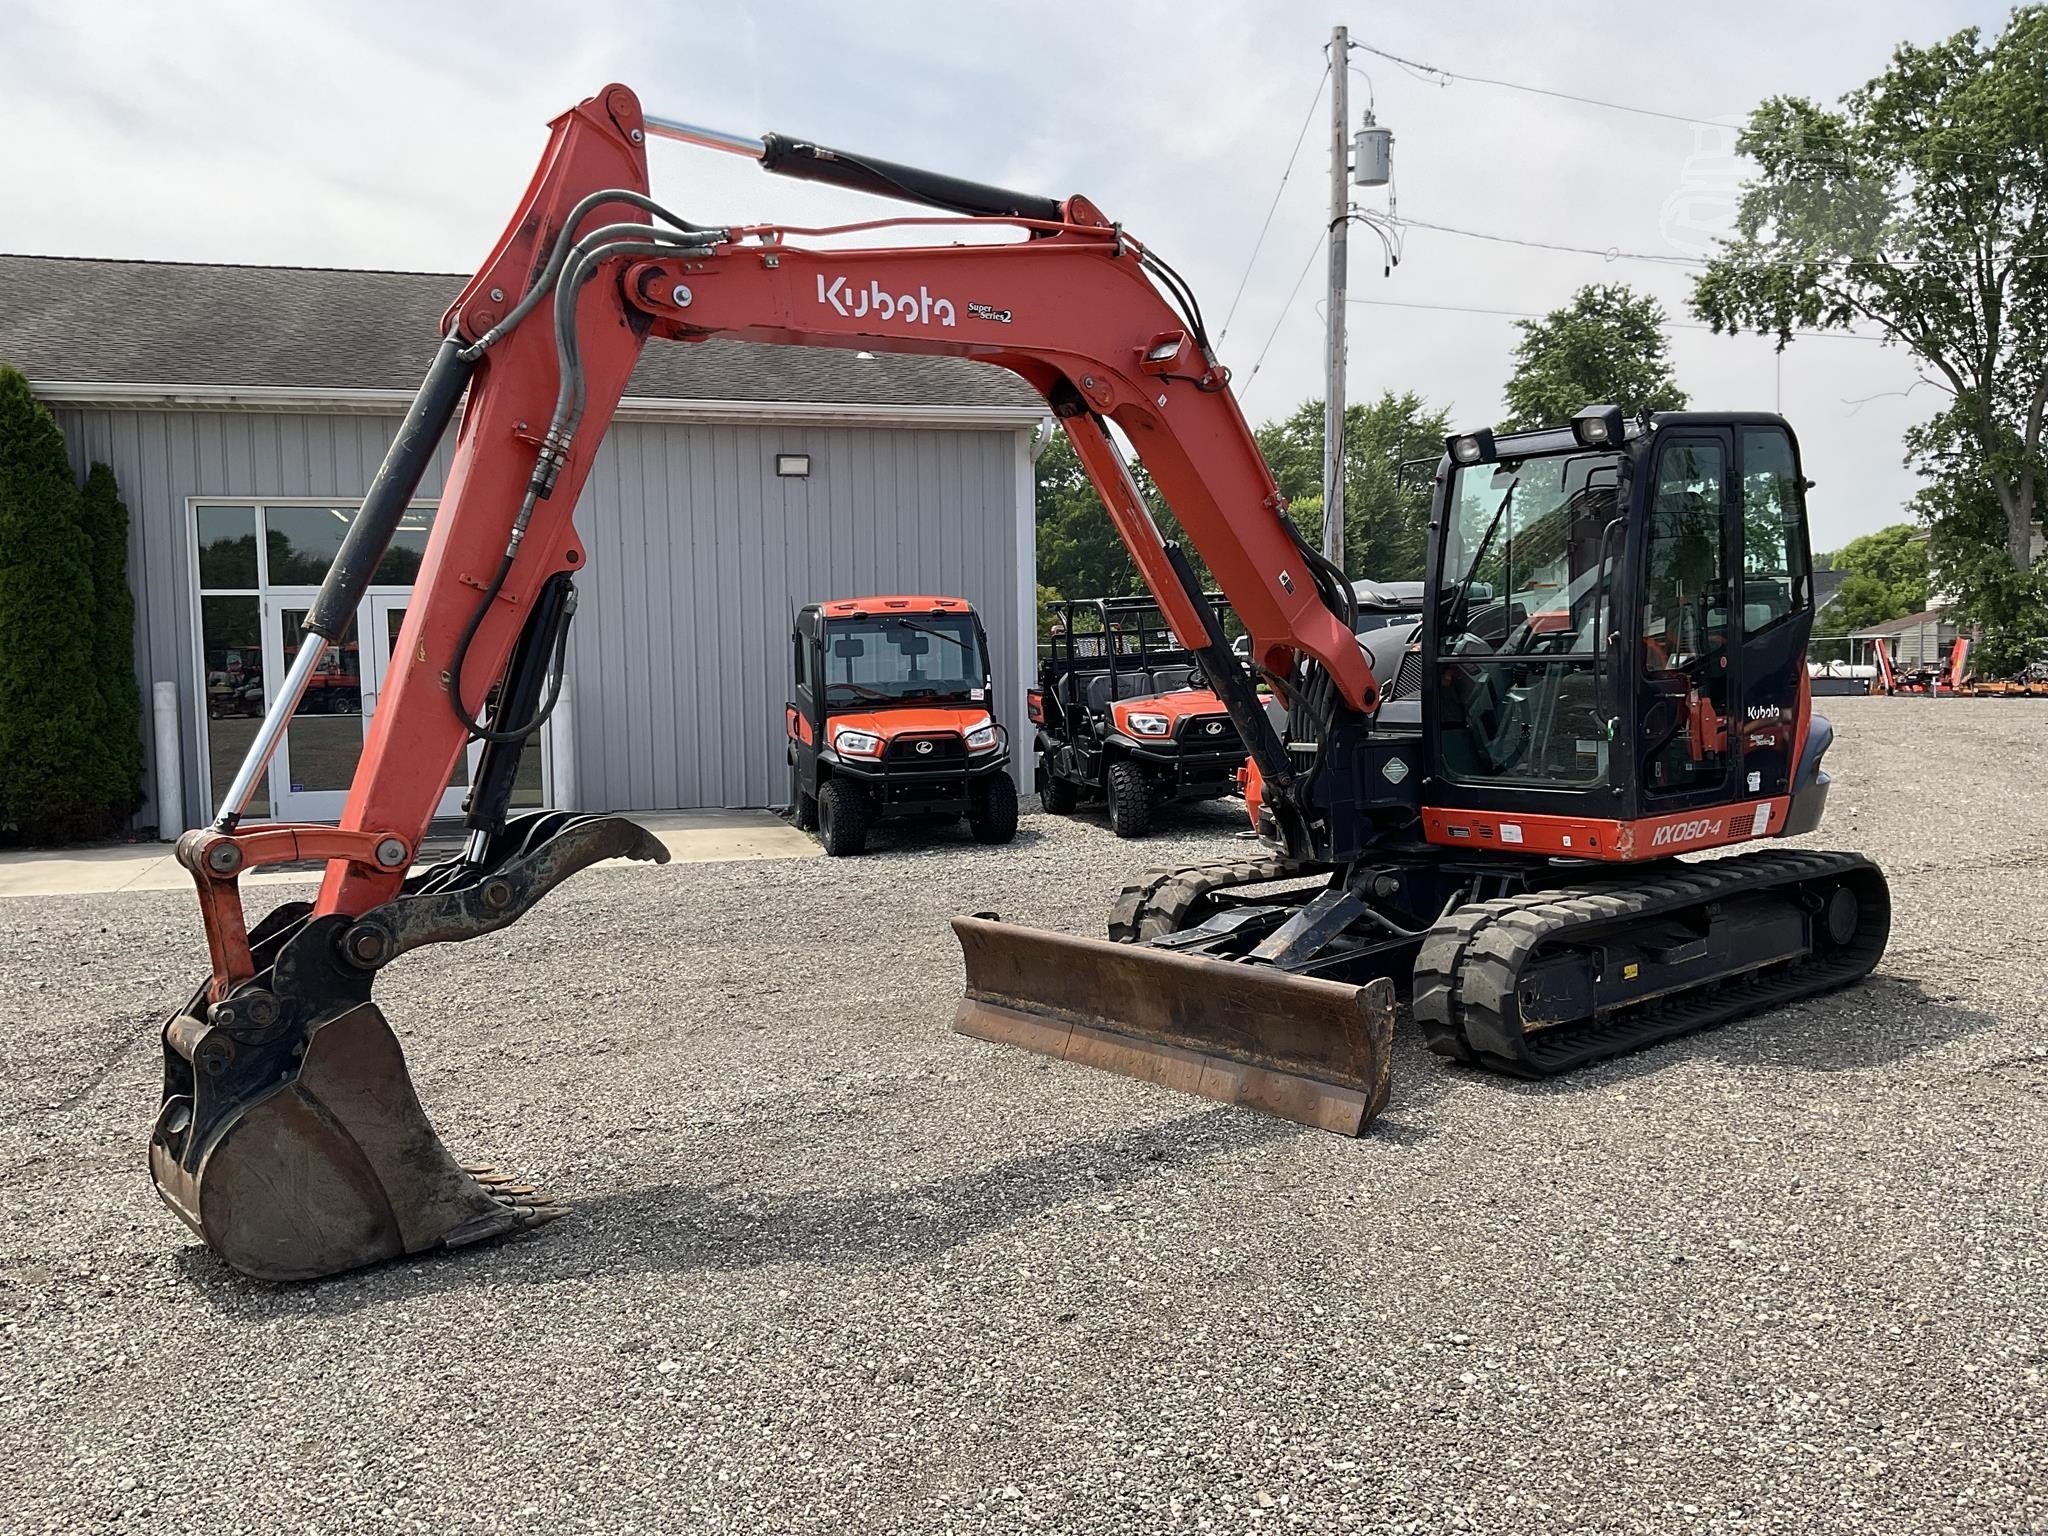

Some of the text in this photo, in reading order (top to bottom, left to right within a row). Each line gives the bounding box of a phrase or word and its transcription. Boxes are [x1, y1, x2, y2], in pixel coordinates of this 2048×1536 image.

[816, 274, 956, 327] Kubota
[968, 302, 992, 313] Super
[1747, 704, 1780, 720] Kubota
[1651, 819, 1722, 847] KX080-4
